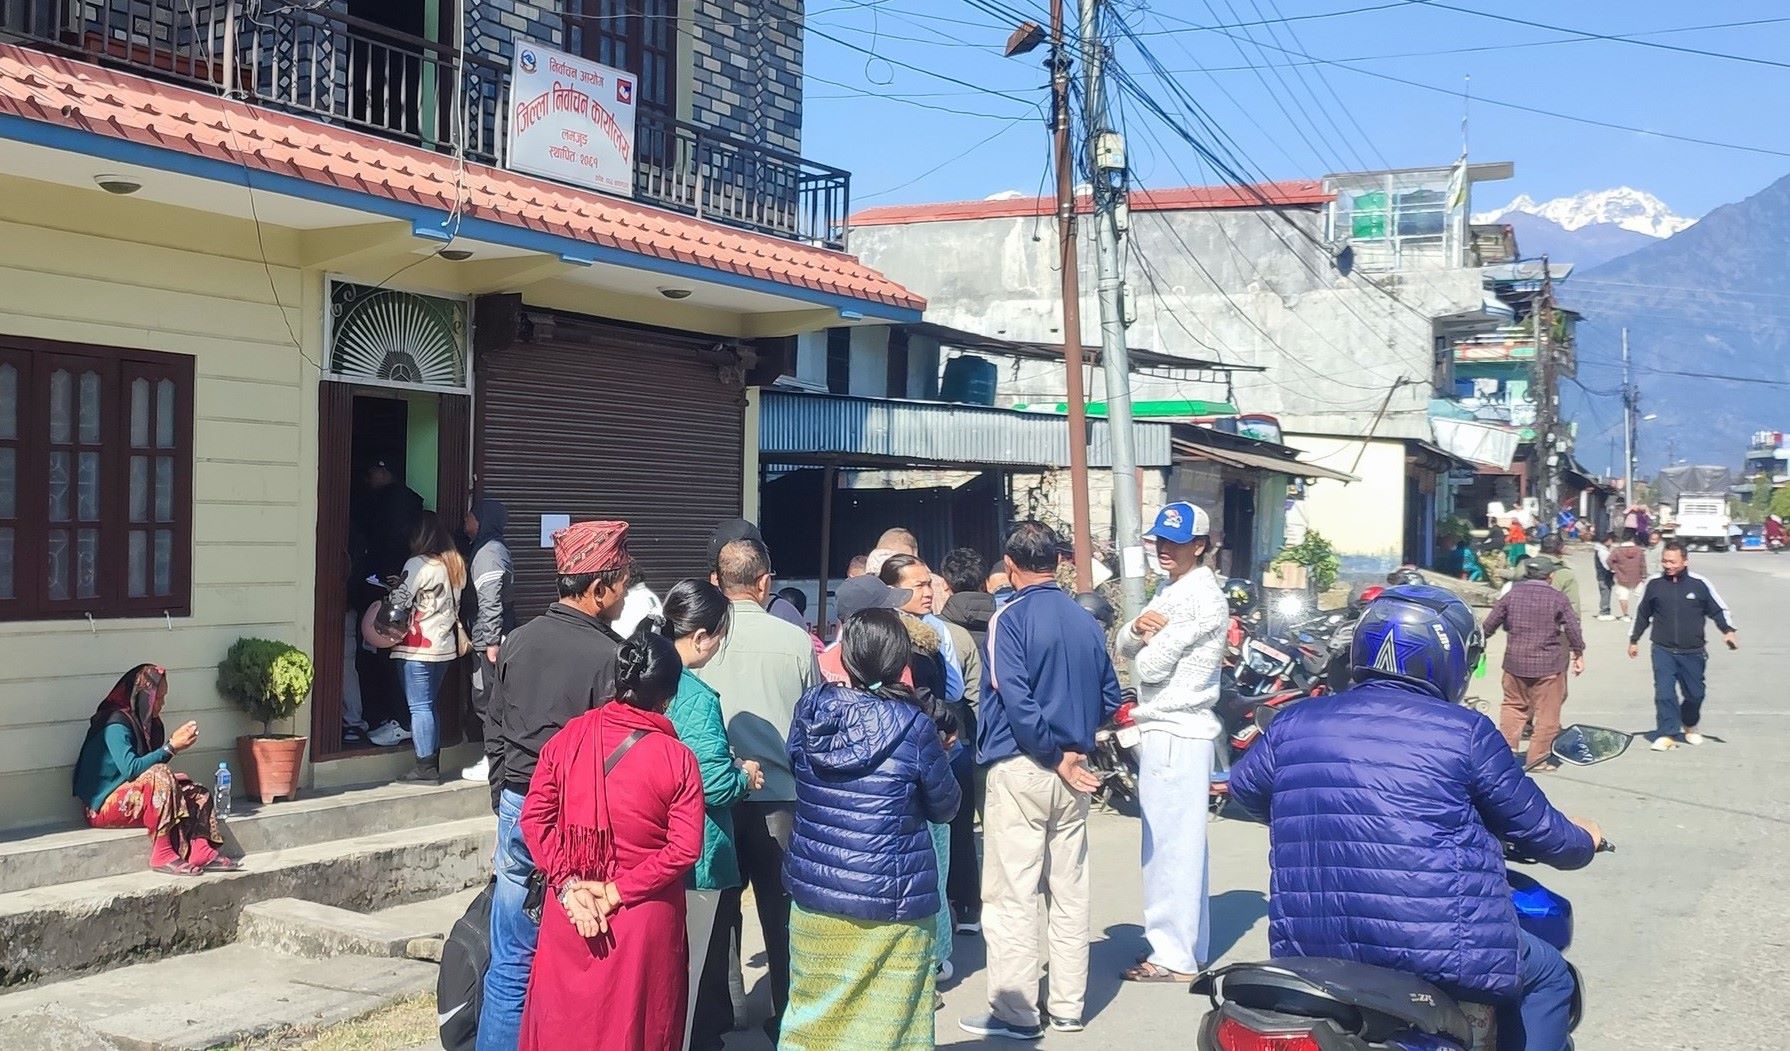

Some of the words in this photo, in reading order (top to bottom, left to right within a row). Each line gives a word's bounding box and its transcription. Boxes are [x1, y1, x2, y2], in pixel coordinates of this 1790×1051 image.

[549, 57, 577, 81] निर्वाचन
[580, 71, 604, 88] आयोग
[516, 92, 549, 136] जिल्ला
[553, 81, 589, 117] निर्वाचन
[591, 100, 630, 165] कार्यालय
[549, 145, 576, 163] स्थापित
